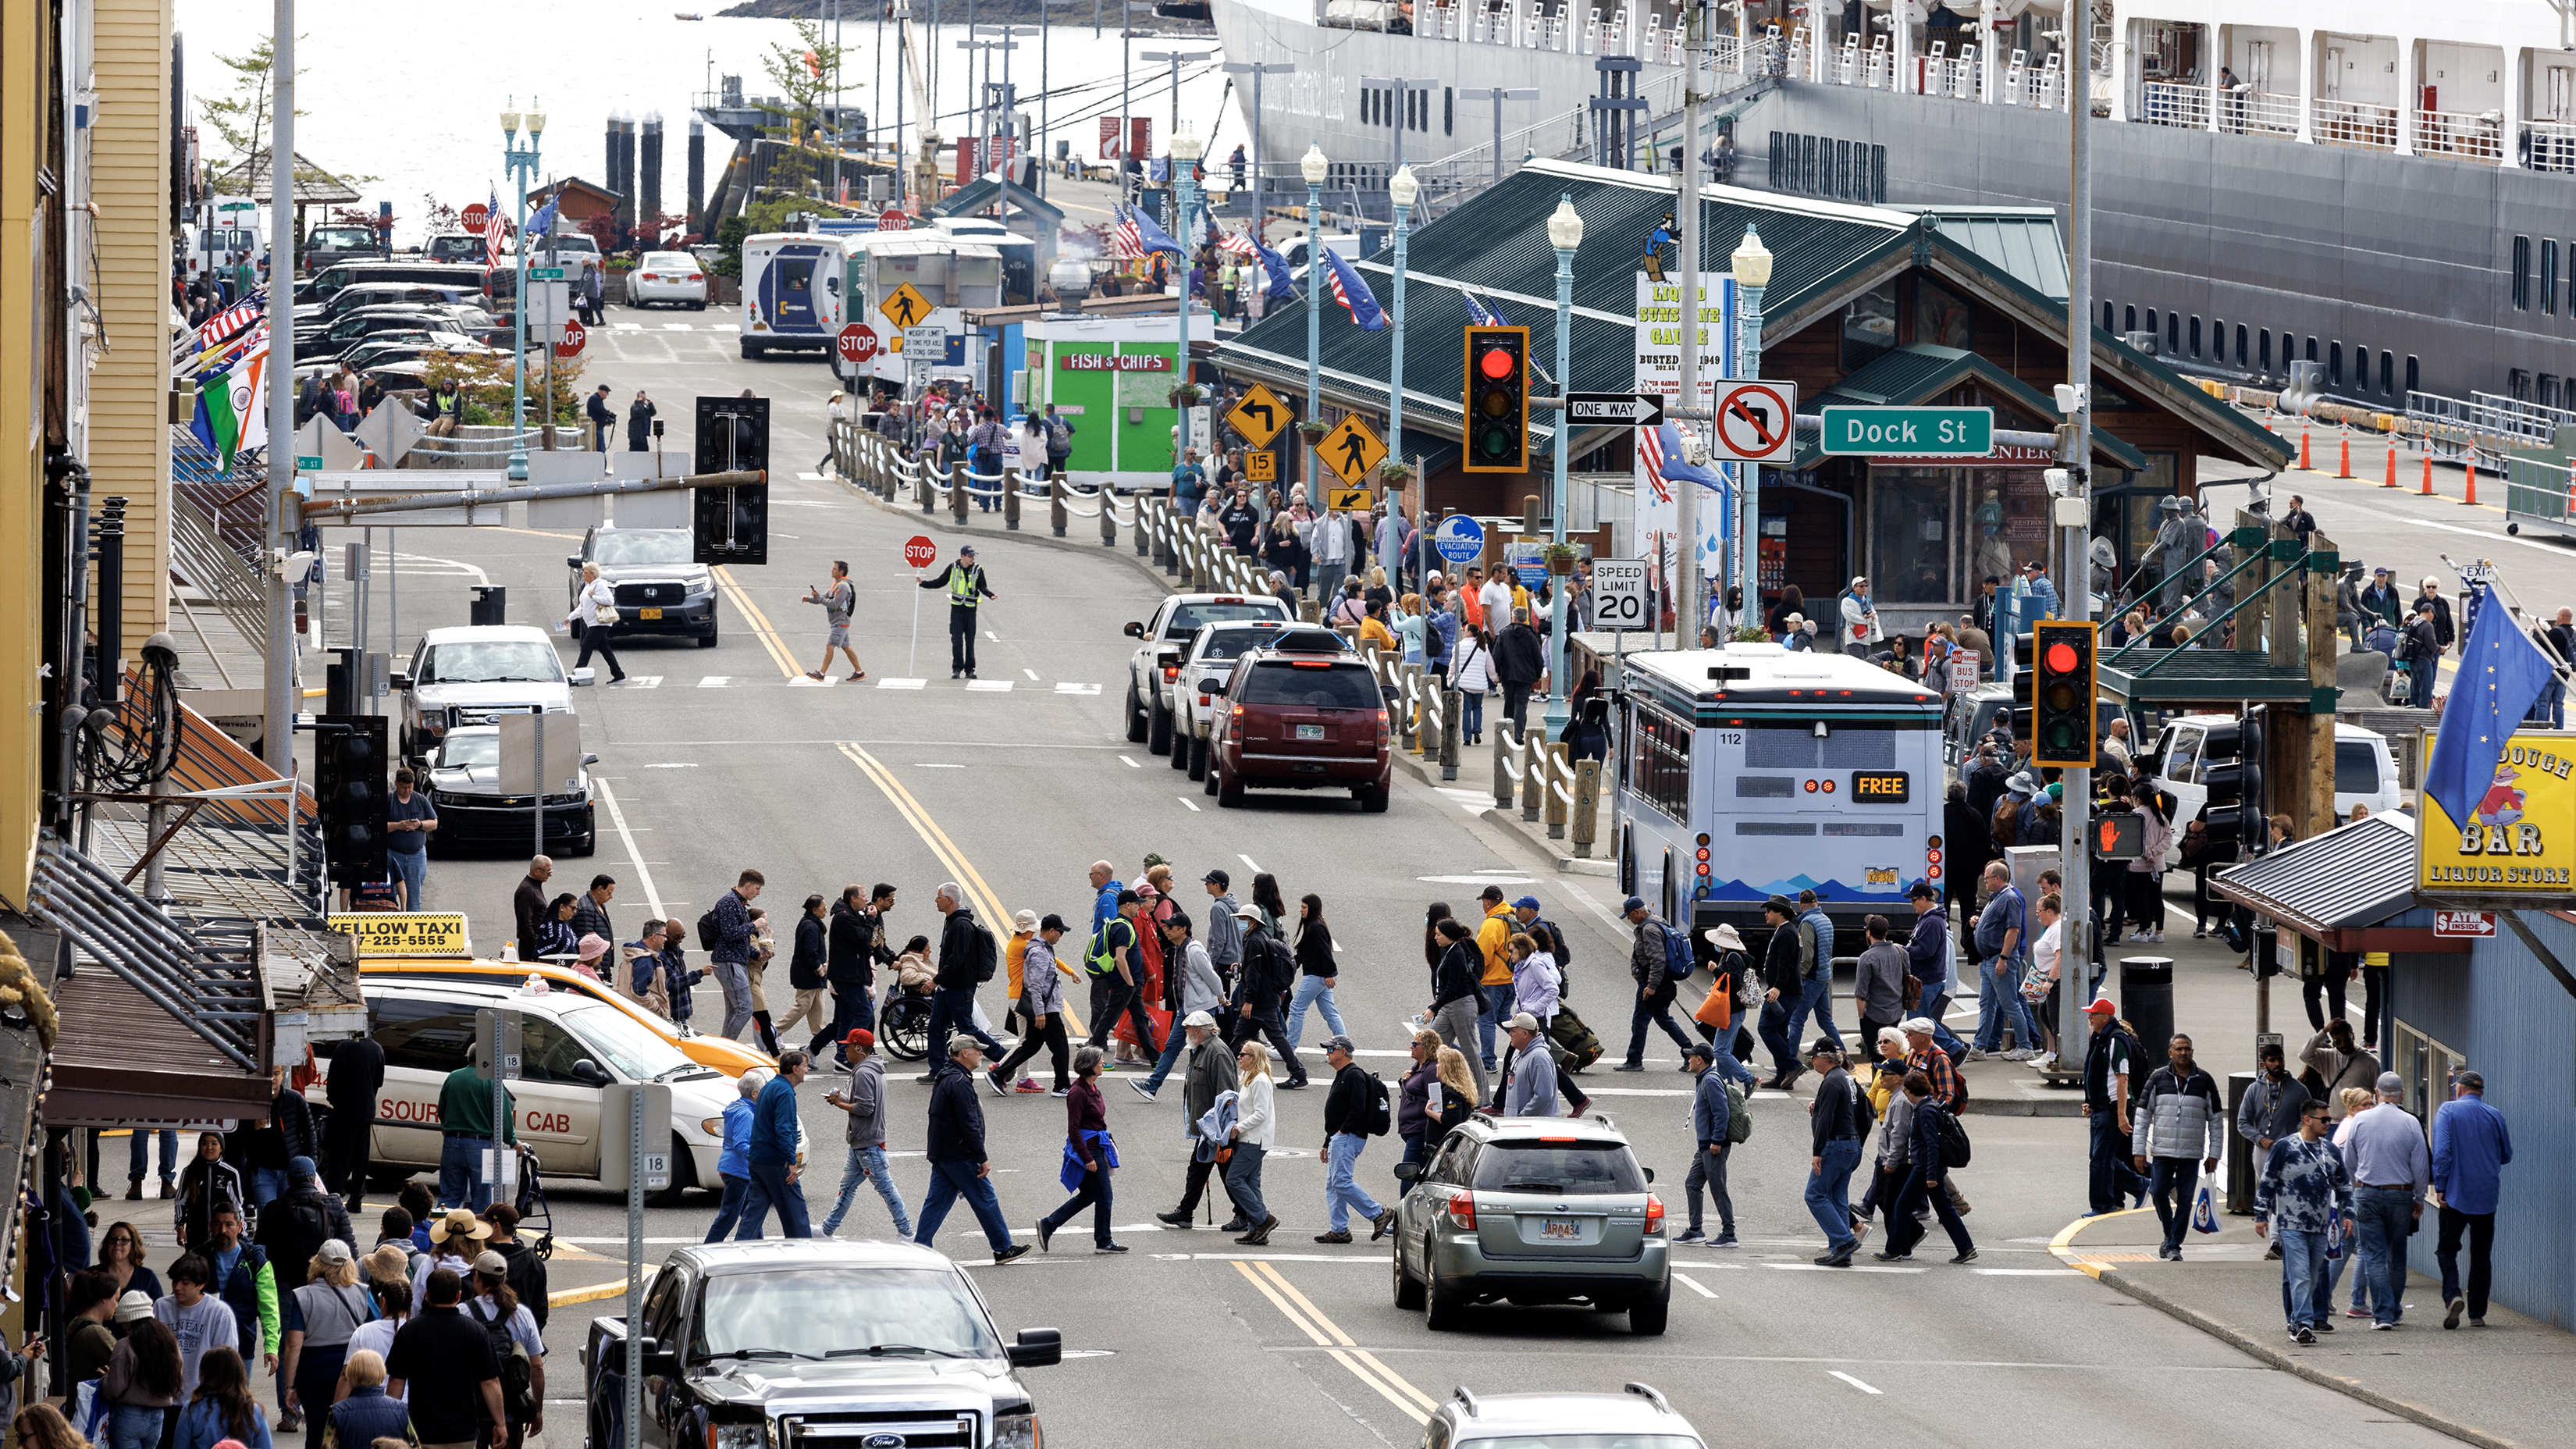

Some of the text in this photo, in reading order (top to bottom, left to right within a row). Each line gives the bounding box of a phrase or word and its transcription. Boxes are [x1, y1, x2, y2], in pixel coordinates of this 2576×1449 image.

[881, 219, 908, 231] STOP
[1653, 286, 1706, 303] LIQD
[1639, 308, 1720, 322] SUNSNE
[1650, 328, 1708, 345] GAUE
[841, 336, 876, 351] STOP
[1070, 354, 1163, 370] FISH & CHIPS
[1639, 355, 1720, 364] BUSTED 1949
[920, 374, 926, 385] 5
[1575, 403, 1636, 415] ONE WAY
[1847, 418, 1967, 443] Dock St
[1252, 455, 1269, 469] 15
[906, 545, 934, 559] STOP
[1598, 567, 1642, 578] SPEED
[1602, 581, 1636, 592] LIMIT
[1599, 595, 1639, 620] 20
[1957, 667, 1973, 676] BUS
[1954, 679, 1975, 688] STOP
[1720, 733, 1741, 745] 112
[2499, 746, 2573, 781] DOUGH
[1859, 778, 1903, 794] FREE
[2459, 823, 2544, 857] BAR
[2431, 865, 2570, 884] LIQUOR STORE
[415, 923, 461, 934] TAXI
[2437, 912, 2482, 932] $ ATM
[359, 935, 446, 945] 7-225-5555
[507, 1057, 517, 1066] 18
[526, 1110, 570, 1133] CAB
[649, 1158, 663, 1170] 18
[1542, 1224, 1580, 1235] JAR 434
[168, 1321, 205, 1334] UNEAU
[872, 1434, 895, 1446] Ford
